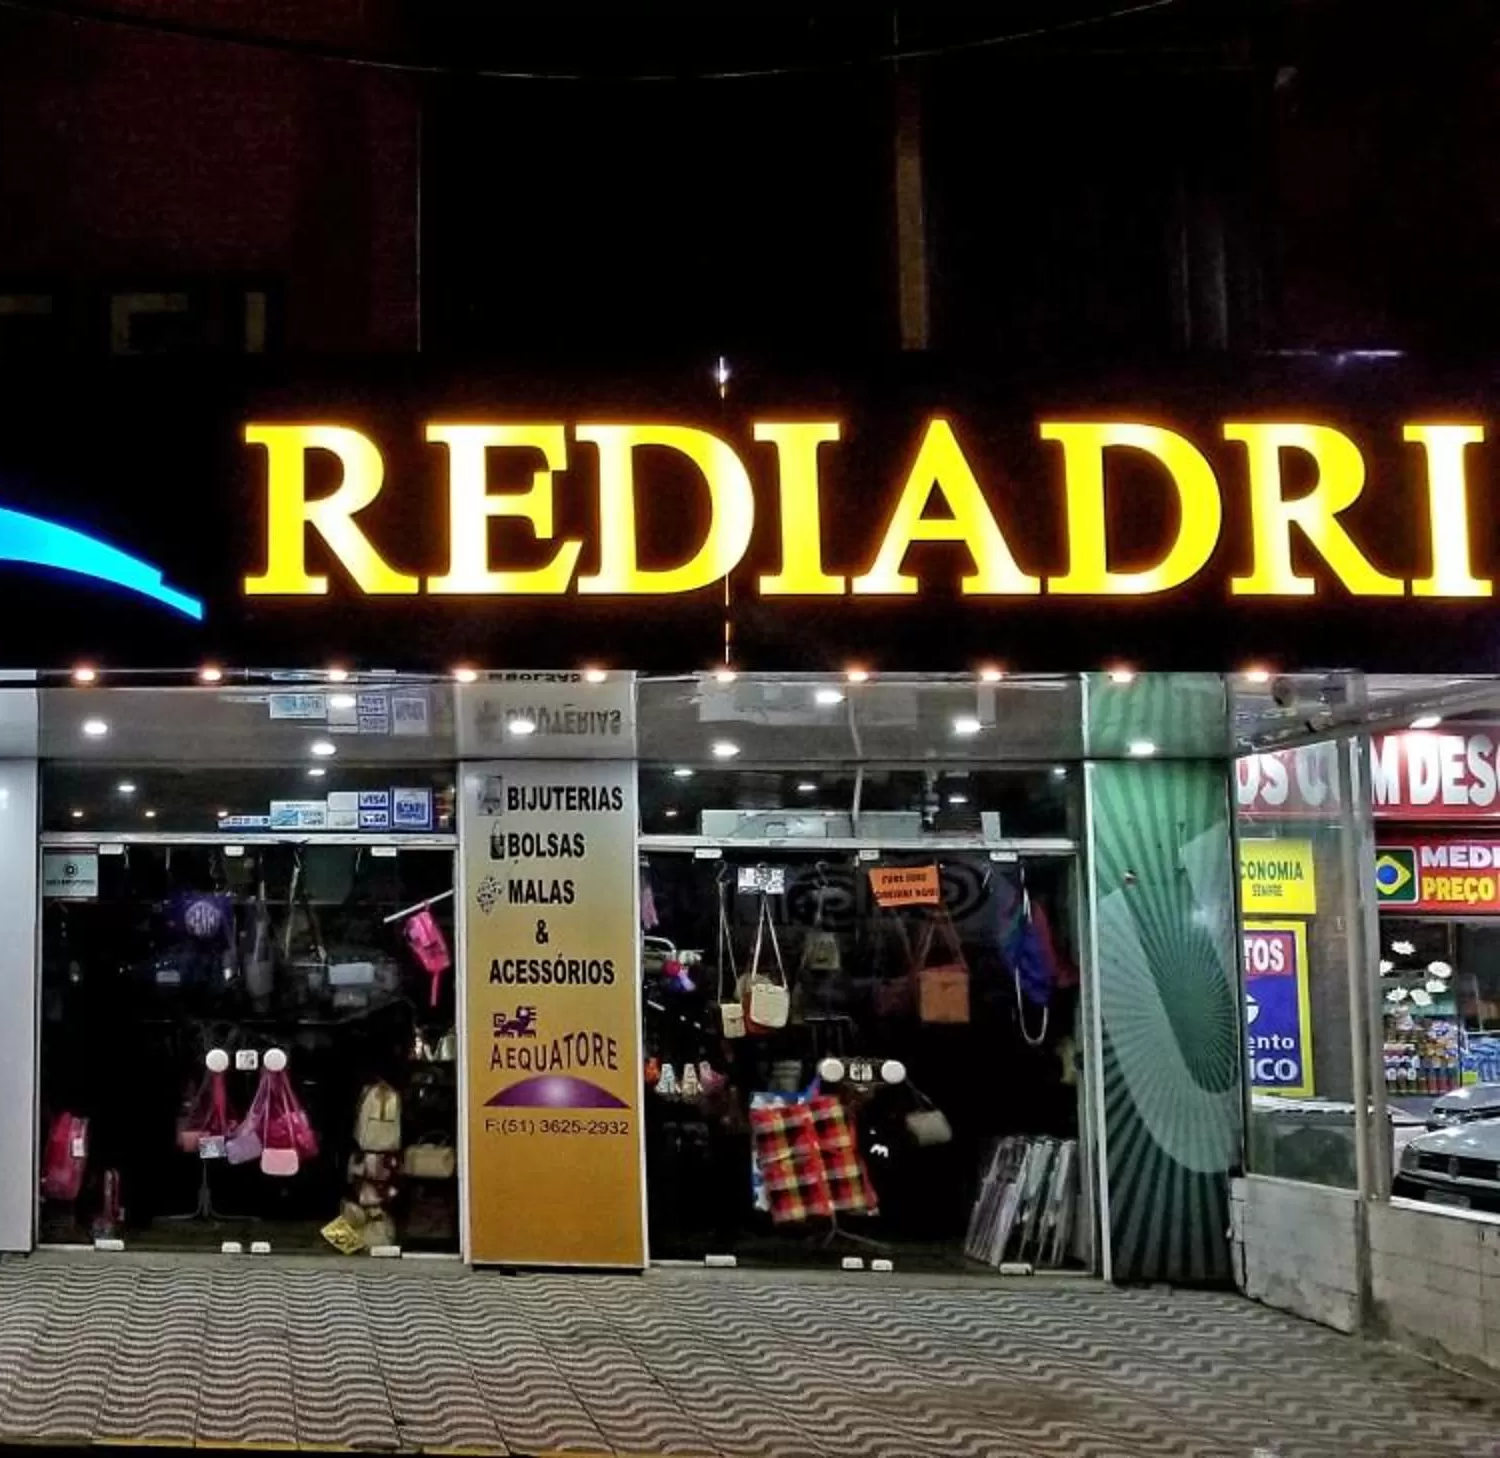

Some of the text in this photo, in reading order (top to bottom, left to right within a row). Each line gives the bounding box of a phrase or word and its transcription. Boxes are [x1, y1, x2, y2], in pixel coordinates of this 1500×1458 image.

[243, 418, 1494, 598] REDIADRI
[1296, 735, 1400, 806] CM
[1407, 734, 1500, 807] DES
[507, 786, 623, 812] BIJUTERIAS
[507, 833, 585, 858] BOLSAS
[508, 879, 575, 905] MALAS
[1422, 877, 1495, 904] PREÇO
[535, 919, 549, 945] &
[489, 952, 615, 985] ACESSÓRIOS
[490, 1031, 618, 1072] AEQUATORE
[539, 1119, 629, 1136] 3625-2932
